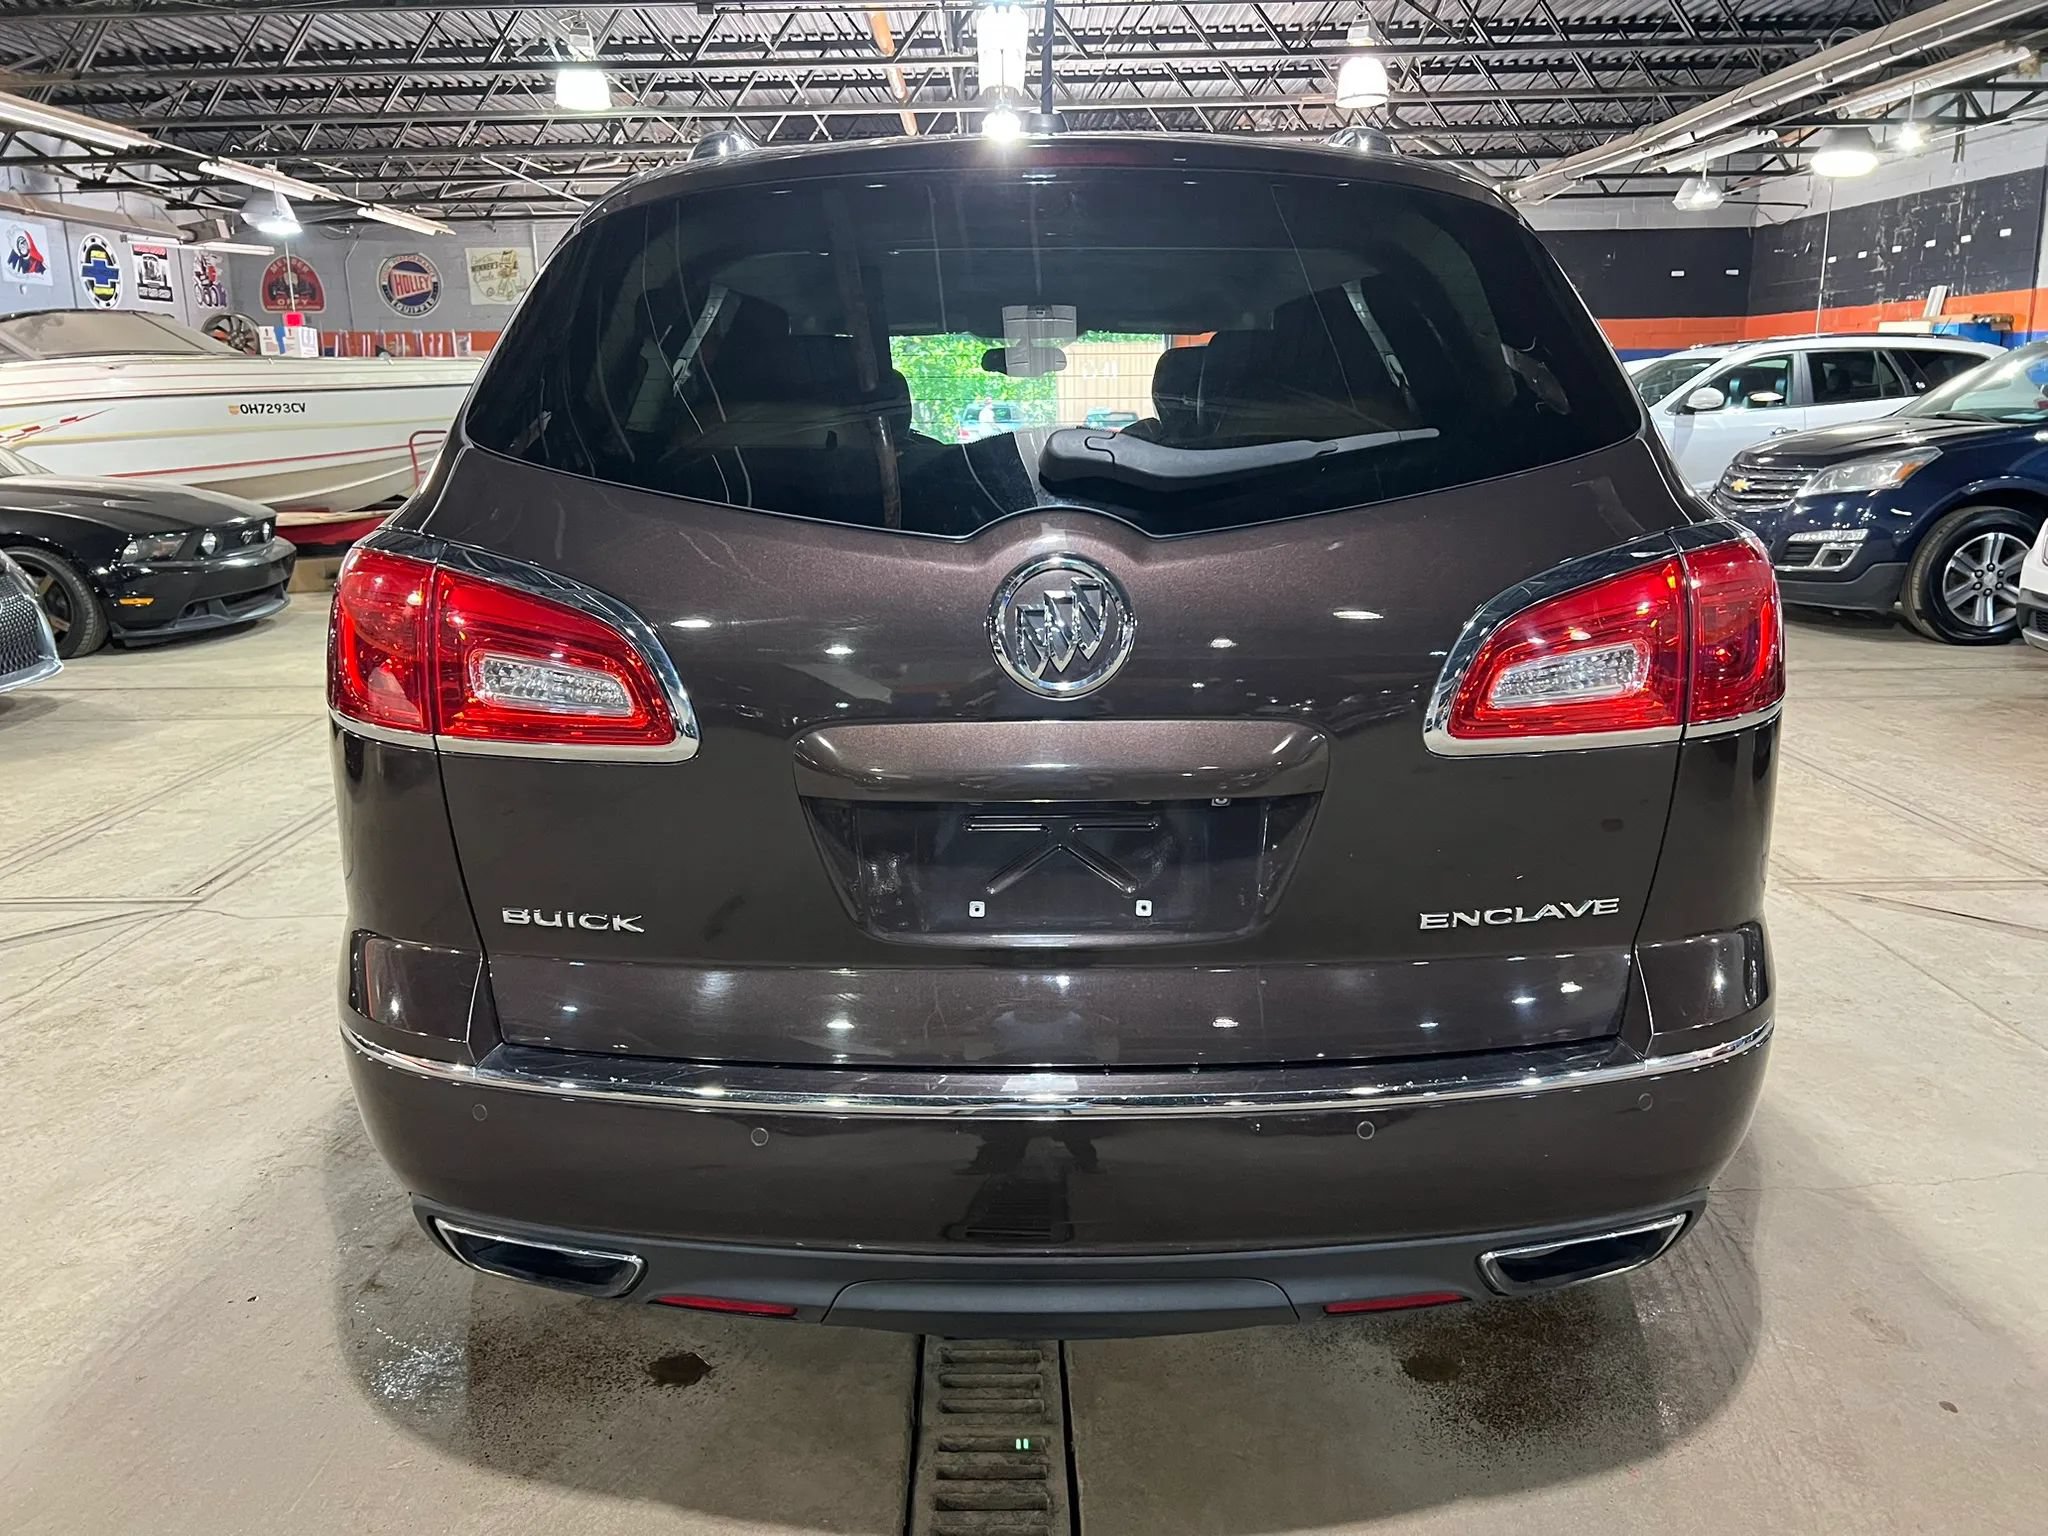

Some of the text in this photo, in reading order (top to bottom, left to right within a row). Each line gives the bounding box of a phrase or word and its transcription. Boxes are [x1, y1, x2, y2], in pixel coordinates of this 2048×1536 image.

[393, 274, 430, 296] HOLLEY
[239, 402, 306, 414] OH7293CV
[502, 906, 645, 933] BUICK
[1419, 897, 1621, 930] ENCLAVE
